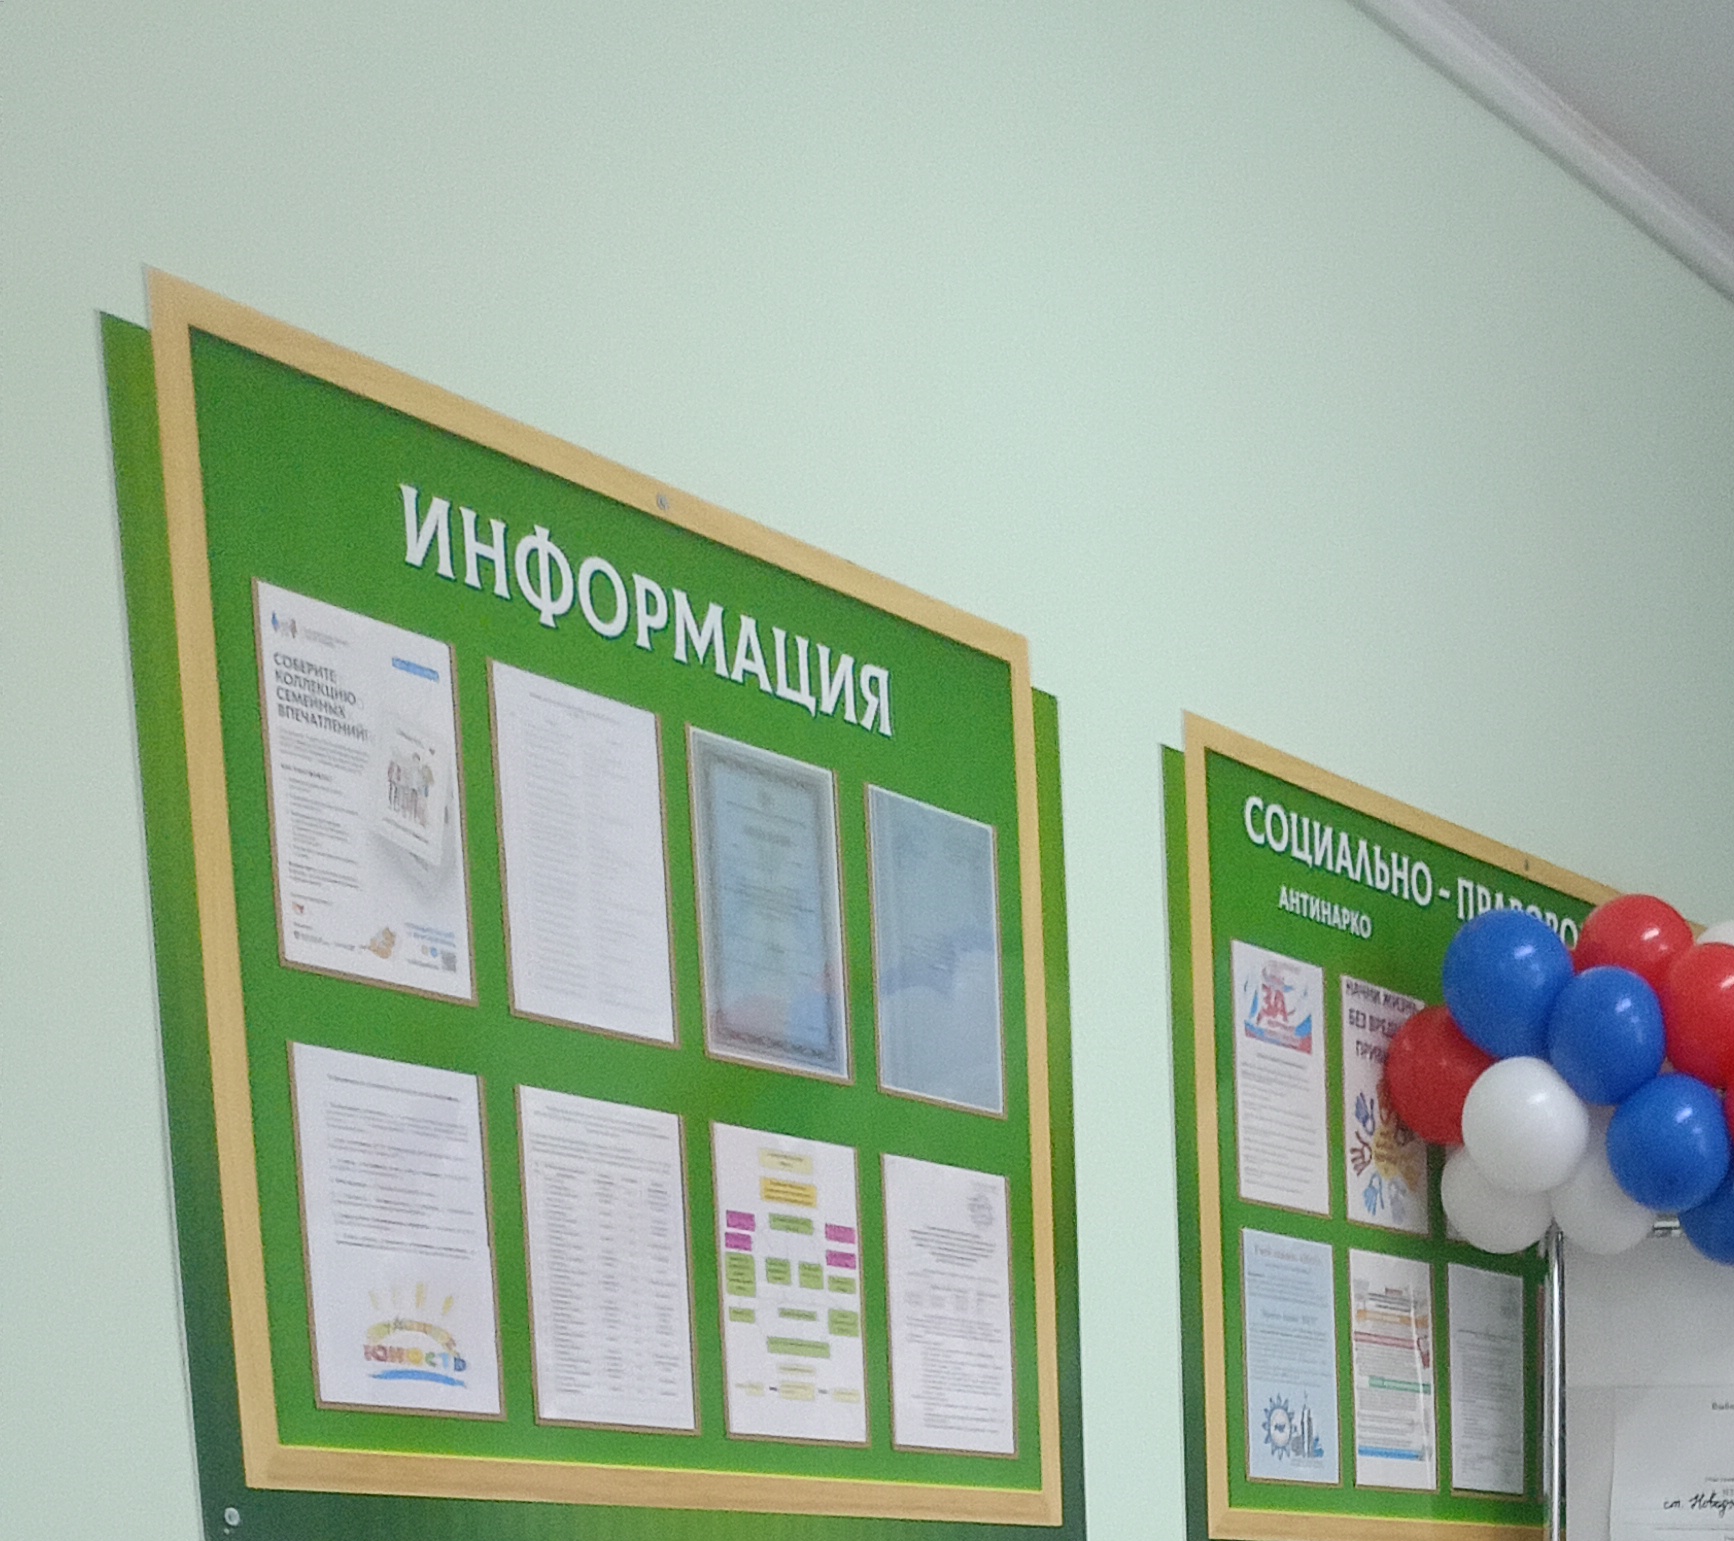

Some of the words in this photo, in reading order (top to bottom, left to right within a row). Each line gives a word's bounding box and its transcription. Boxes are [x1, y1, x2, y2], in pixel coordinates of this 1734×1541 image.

[400, 484, 893, 738] ИНФОРМАЦИЯ
[273, 651, 337, 684] СОБЕРИТЕ
[275, 669, 357, 707] КОЛЛЕКЦИЮ
[276, 685, 346, 719] СЕМЕЙНЫХ
[1244, 795, 1433, 906] СОЦИАЛЬНО
[1279, 885, 1373, 940] АНТИНАРКО
